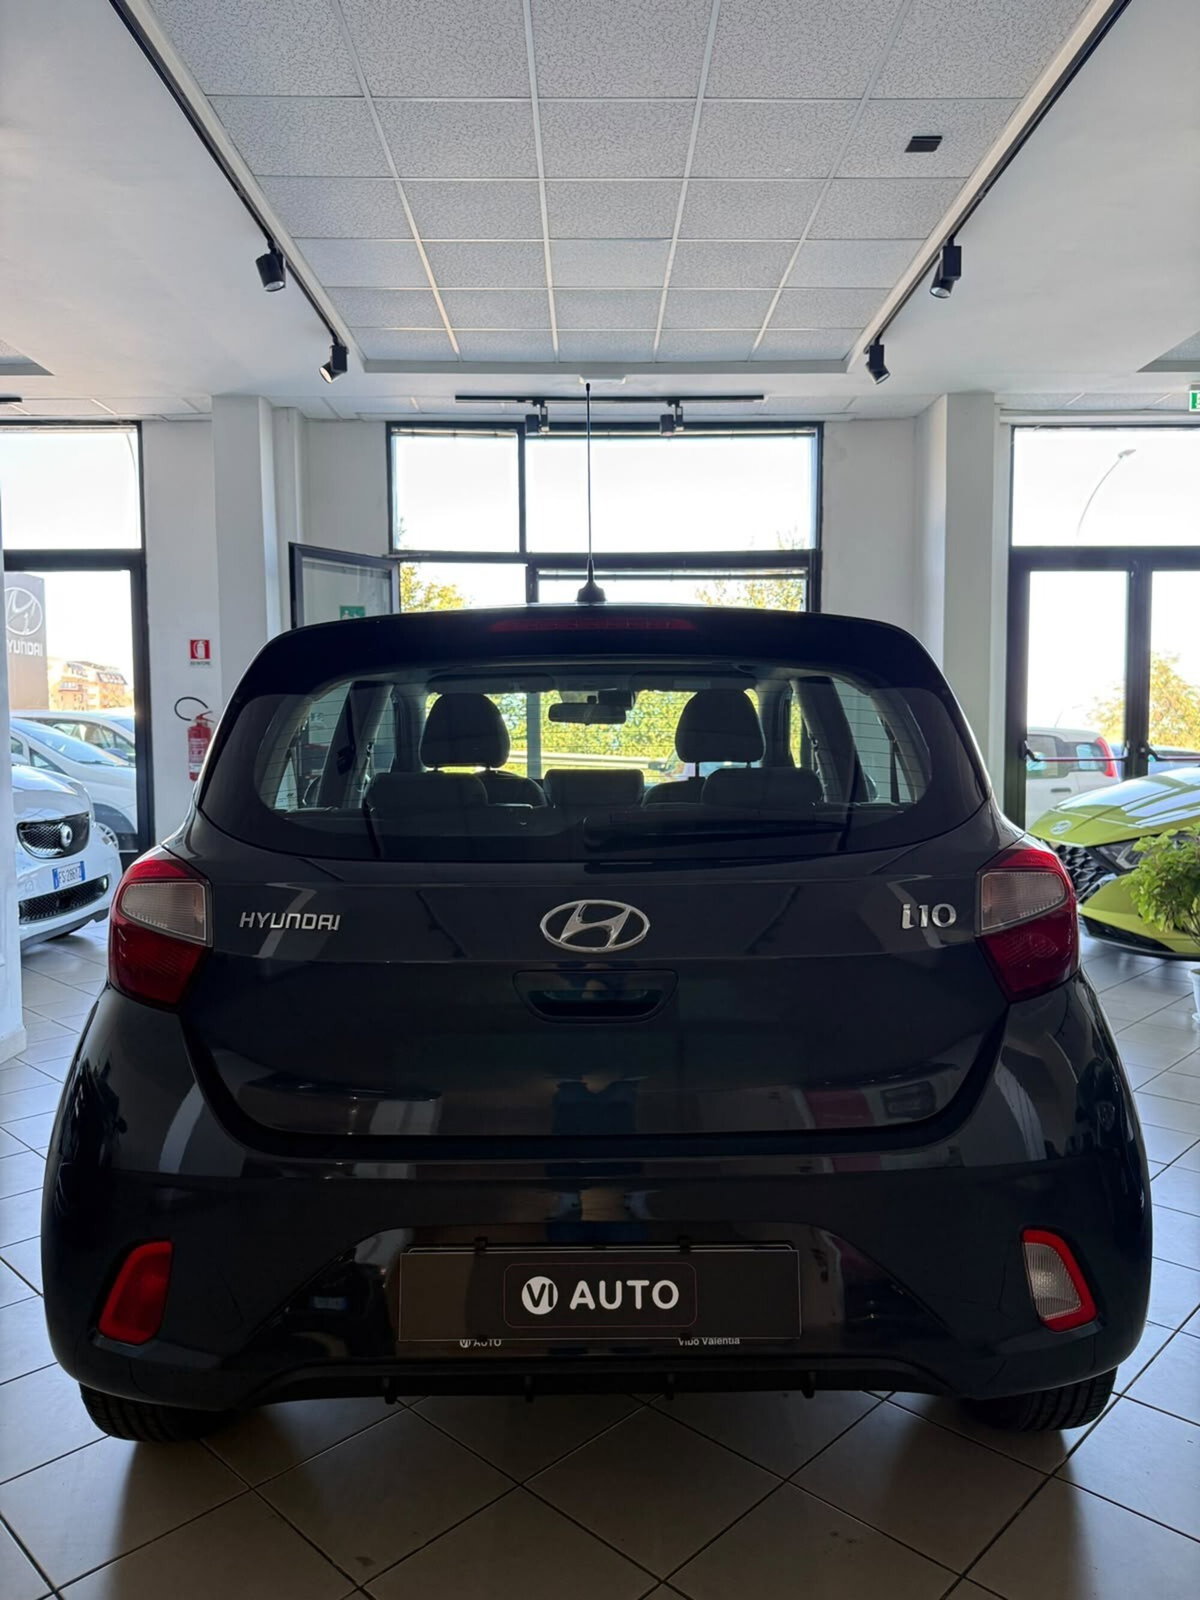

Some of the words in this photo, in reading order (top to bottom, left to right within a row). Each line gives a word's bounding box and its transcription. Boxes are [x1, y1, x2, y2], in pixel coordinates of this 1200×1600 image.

[7, 639, 43, 656] YUNDAI
[240, 911, 341, 931] HYUNDAI
[902, 903, 957, 929] i10
[569, 1279, 680, 1311] AUTO
